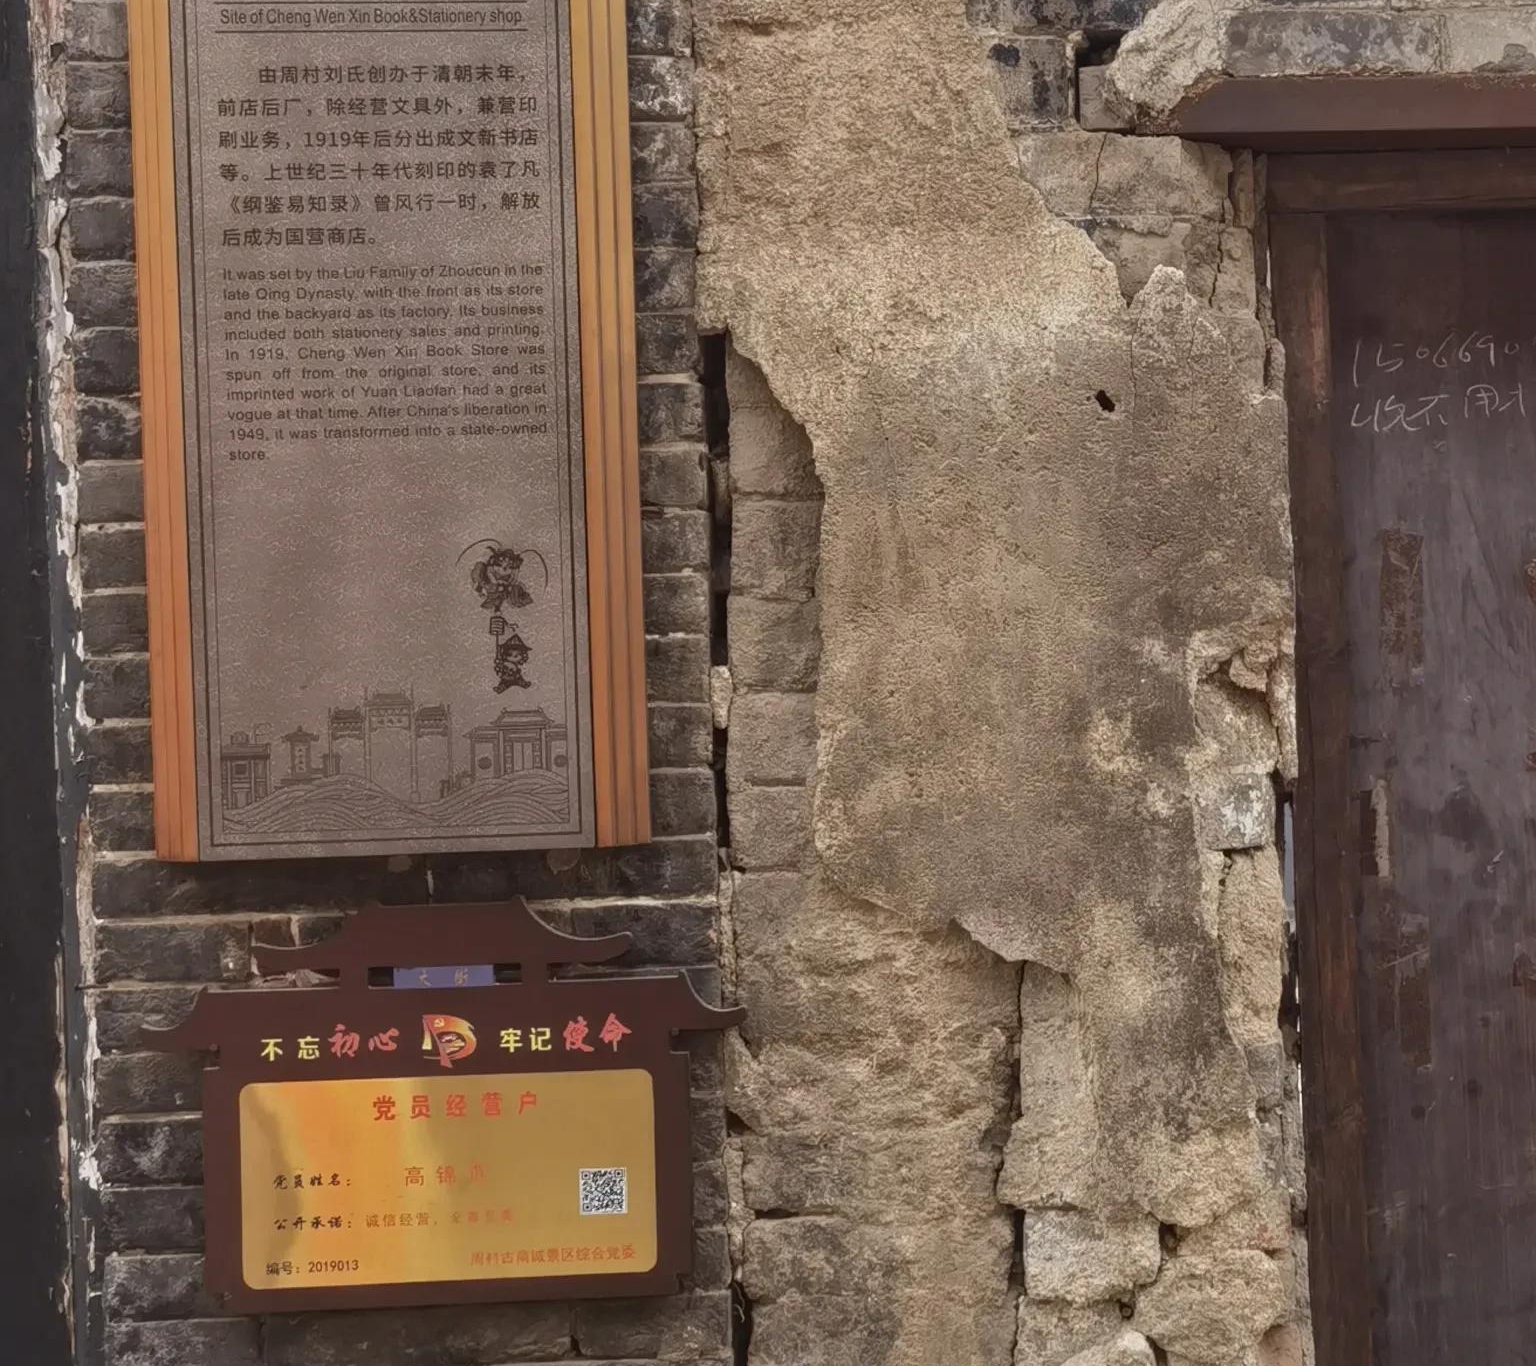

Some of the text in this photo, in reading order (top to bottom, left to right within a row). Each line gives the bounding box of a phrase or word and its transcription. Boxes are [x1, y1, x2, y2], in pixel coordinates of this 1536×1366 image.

[221, 9, 247, 24] Site
[251, 9, 263, 24] of
[267, 9, 311, 27] Cheng
[314, 9, 345, 23] Wen
[350, 9, 370, 23] Xin
[490, 8, 522, 25] shop
[222, 227, 376, 246] 后成为国营商店。
[223, 264, 543, 281] It was set by the Liu Family of Zhoucun in the
[224, 289, 249, 300] late
[256, 288, 290, 302] Qing
[363, 287, 392, 298] with
[399, 287, 420, 297] the
[427, 286, 459, 297] front
[465, 287, 480, 296] as
[487, 286, 502, 296] its
[507, 286, 543, 295] store
[224, 309, 250, 320] and
[257, 308, 280, 320] the
[285, 307, 350, 321] backyard
[357, 309, 374, 318] as
[380, 307, 396, 318] its
[459, 305, 476, 316] Its
[482, 305, 543, 316] business
[225, 328, 286, 341] included
[293, 327, 324, 340] both
[332, 326, 402, 340] stationery
[410, 326, 446, 337] sales
[455, 324, 480, 336] and
[226, 349, 239, 360] In
[298, 347, 345, 361] Cheng
[354, 346, 385, 358] Wen
[395, 346, 417, 357] Xin
[427, 345, 462, 357] Book
[471, 344, 508, 356] Store
[517, 344, 545, 354] was
[226, 371, 261, 383] spun
[272, 368, 291, 379] off
[302, 368, 334, 379] from
[346, 368, 367, 378] the
[379, 365, 431, 380] original
[492, 364, 518, 375] and
[530, 363, 545, 374] its
[227, 384, 547, 402] imprinted work of Yuan Liaofan had a great
[228, 410, 272, 422] vogue
[277, 408, 291, 419] at
[296, 408, 323, 419] that
[368, 406, 401, 417] After
[465, 403, 529, 415] liberation
[536, 403, 546, 413] in
[275, 428, 284, 440] it
[289, 430, 317, 439] was
[324, 427, 409, 436] transformed
[416, 424, 441, 435] into
[447, 426, 455, 435] a
[461, 423, 547, 435] state-owned
[260, 1013, 632, 1061] 不忘初心 牢记使命
[372, 1091, 539, 1121] 党员经营户
